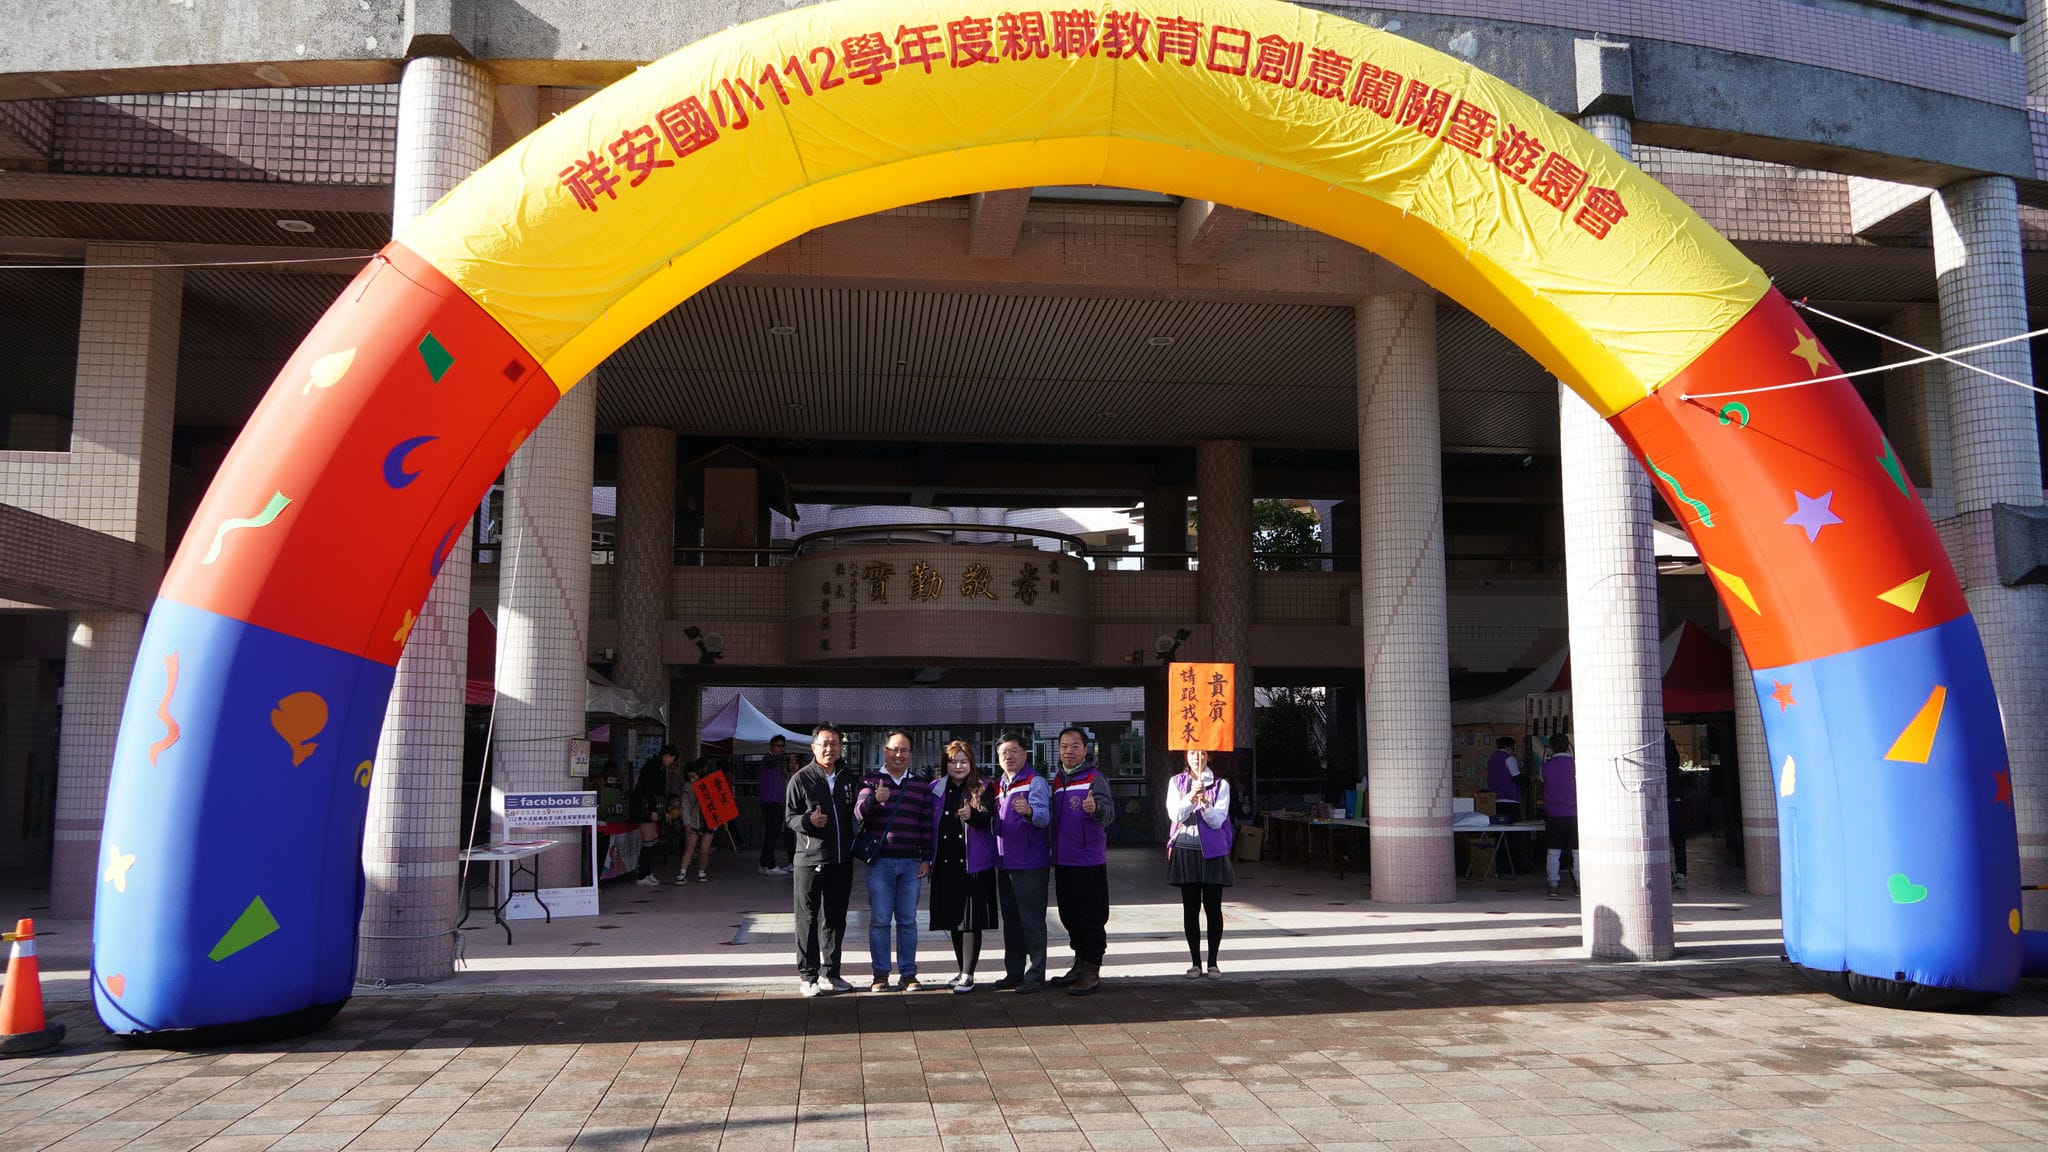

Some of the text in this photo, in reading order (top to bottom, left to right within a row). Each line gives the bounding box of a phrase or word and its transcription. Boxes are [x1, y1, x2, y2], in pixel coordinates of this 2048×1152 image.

[559, 9, 1629, 241] 祥安國小112學年度親職教育日創意闖關暨遊園會
[1207, 672, 1228, 723] 貴賓
[520, 797, 580, 807] facebook
